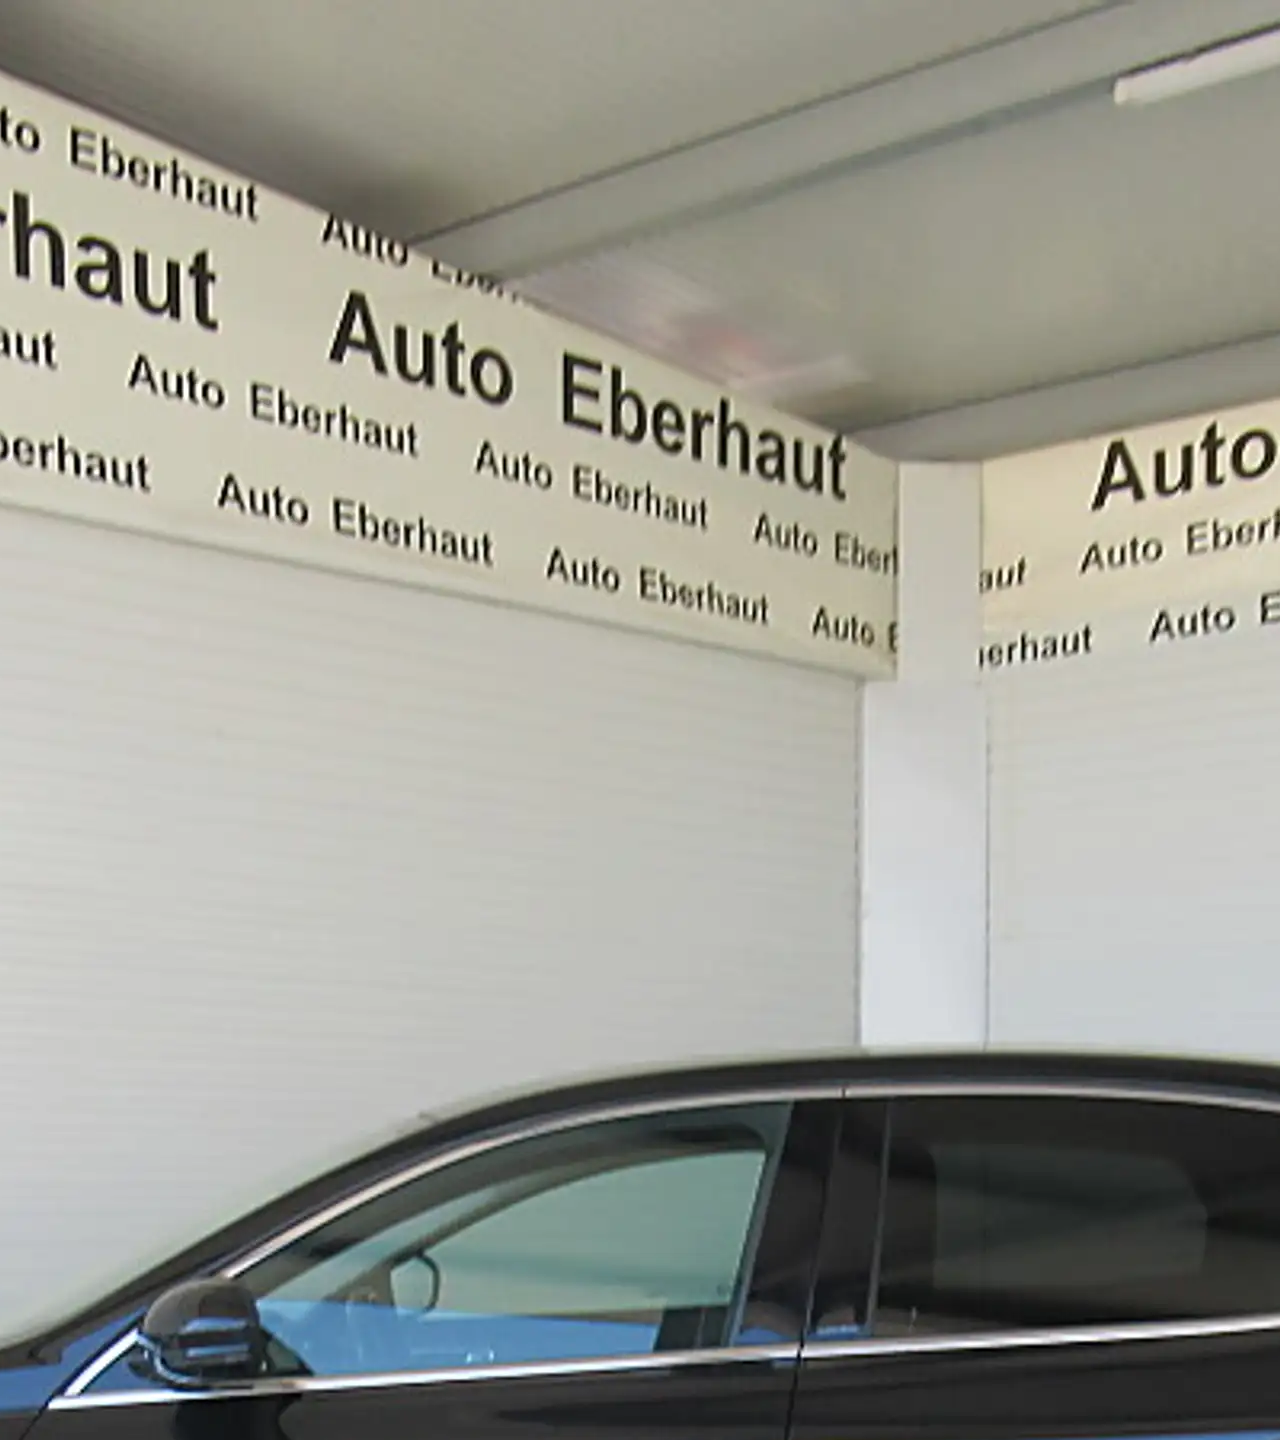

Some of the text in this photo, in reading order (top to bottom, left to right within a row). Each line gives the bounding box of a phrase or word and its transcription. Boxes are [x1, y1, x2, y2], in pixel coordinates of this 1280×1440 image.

[70, 126, 259, 221] Eberhaut
[129, 354, 419, 458] Auto Eberhaut
[329, 291, 848, 501] Auto Eberhaut
[476, 441, 706, 528] Auto Eberhaut
[1091, 422, 1277, 511] Auto
[218, 473, 491, 563] Auto Eberhaut
[754, 513, 818, 556] Auto
[1081, 537, 1163, 574] Auto
[547, 548, 768, 624] Auto Eberhaut
[812, 606, 875, 646] Auto
[1150, 606, 1236, 642] Auto
